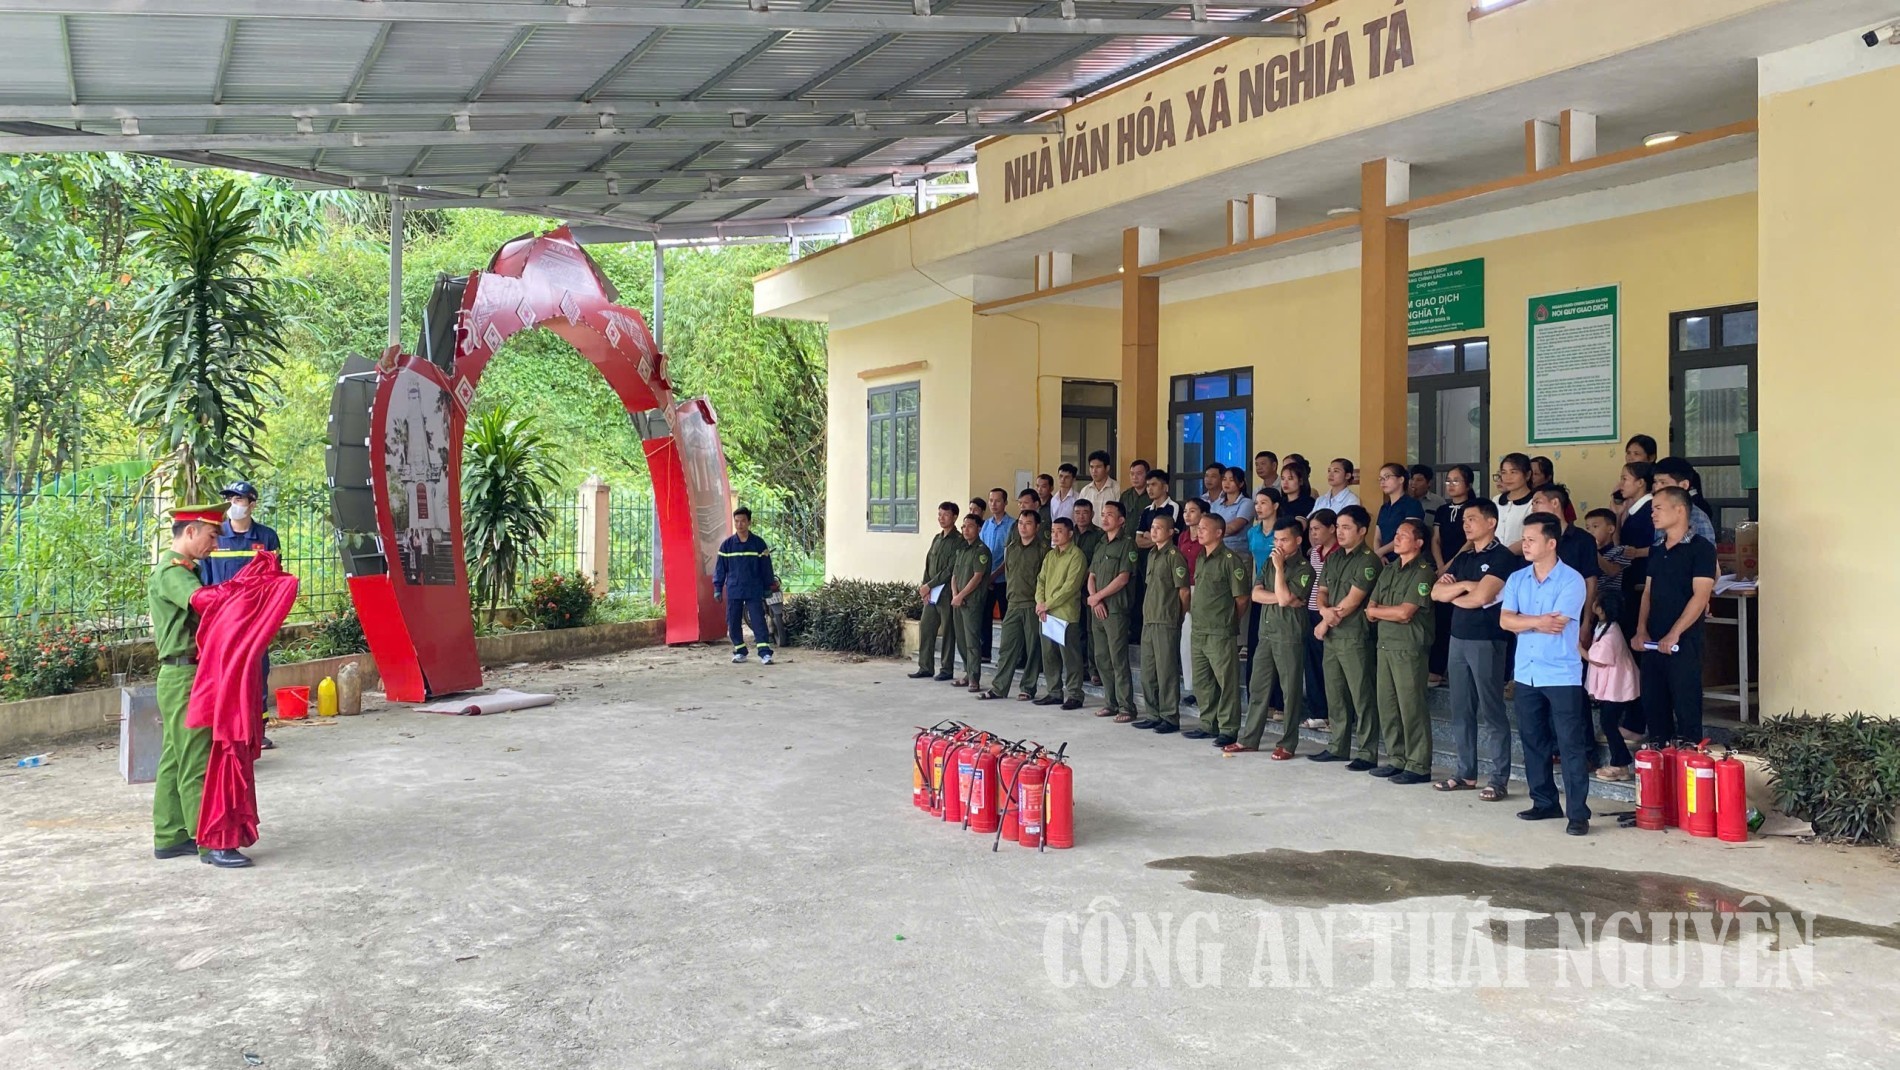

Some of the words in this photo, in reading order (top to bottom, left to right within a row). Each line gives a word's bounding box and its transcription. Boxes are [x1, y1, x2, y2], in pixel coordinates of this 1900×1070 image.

[1004, 136, 1054, 204] NHÀ
[1057, 122, 1110, 185] VĂN
[1116, 92, 1176, 166] HÓA
[1184, 65, 1231, 142] XÃ
[1238, 16, 1355, 124] NGHĨA
[1362, 0, 1415, 80] TÁ
[1415, 297, 1436, 307] GIAO
[1438, 293, 1459, 305] DỊCH
[1434, 305, 1445, 315] TÁ
[1576, 305, 1593, 314] GIAO
